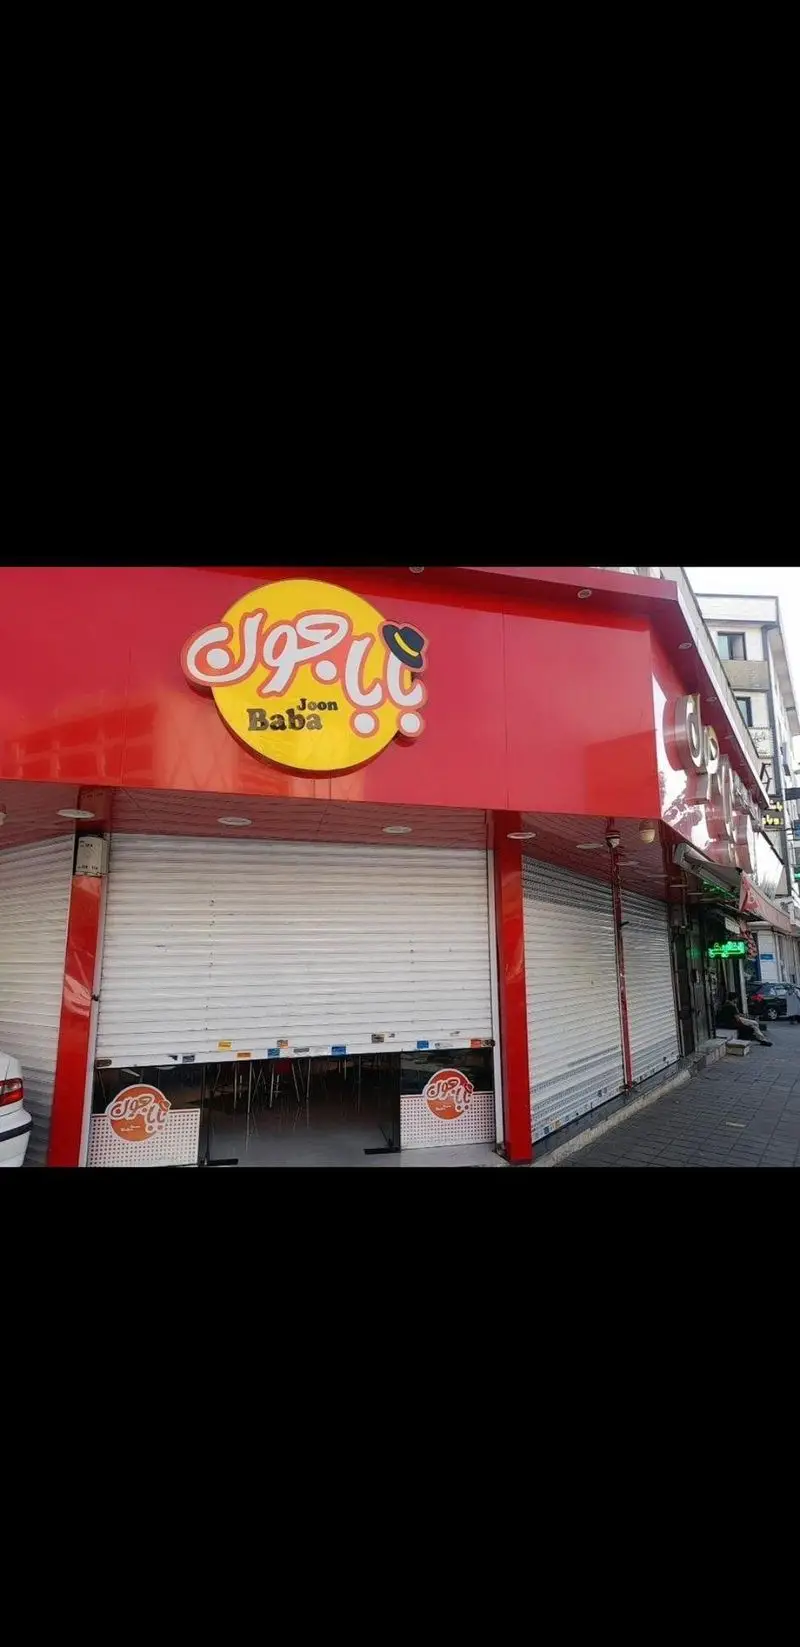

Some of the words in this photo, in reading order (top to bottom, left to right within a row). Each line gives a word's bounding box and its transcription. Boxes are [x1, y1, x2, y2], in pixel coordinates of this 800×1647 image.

[185, 611, 349, 694] جون
[297, 698, 338, 711] Joon
[345, 636, 424, 735] بابا
[246, 708, 323, 731] Baba
